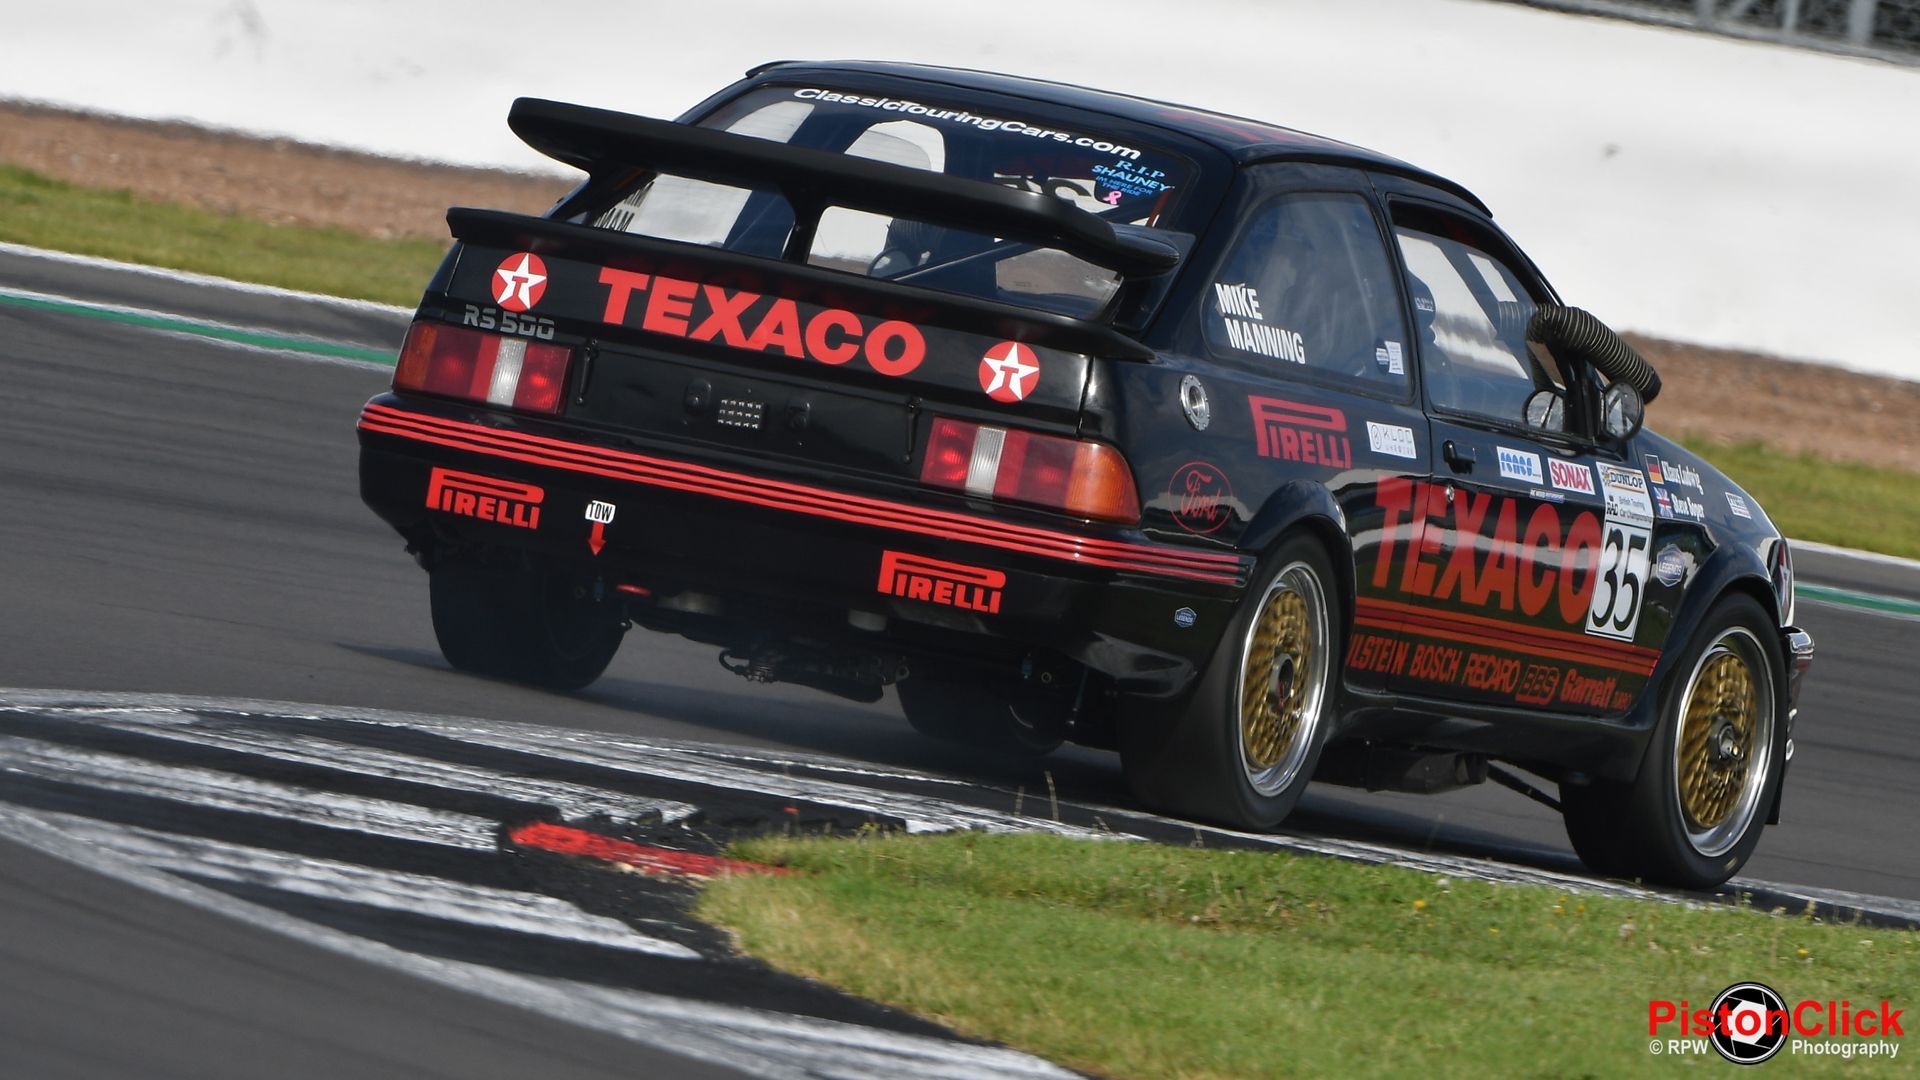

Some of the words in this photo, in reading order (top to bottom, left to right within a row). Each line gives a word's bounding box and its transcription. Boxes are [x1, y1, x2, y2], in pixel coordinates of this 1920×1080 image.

[794, 88, 1141, 160] ClassicTouringCars.com
[1092, 165, 1169, 191] SHAUNEY
[1134, 184, 1153, 195] FOR
[463, 304, 496, 329] RS
[500, 312, 555, 340] 500
[599, 267, 926, 376] TEXACO
[1214, 283, 1263, 320] MIKE
[1224, 318, 1306, 364] MANNING
[1248, 395, 1352, 469] PIRELLI
[425, 467, 545, 529] PIRELLI
[1180, 469, 1223, 521] Ford
[1550, 461, 1592, 491] SONAX
[1610, 472, 1643, 489] DUNLOP
[590, 502, 613, 522] TOW
[1371, 474, 1603, 624] TEXACO
[1658, 561, 1682, 576] LEGENDS
[877, 549, 1006, 614] PIRELLI
[1592, 526, 1648, 631] 35
[1346, 633, 1410, 675] ILSTEIN
[1408, 644, 1463, 682] BOSCH
[1462, 653, 1521, 693] RECARO
[1518, 664, 1560, 704] BBS
[1560, 668, 1616, 710] Garrett
